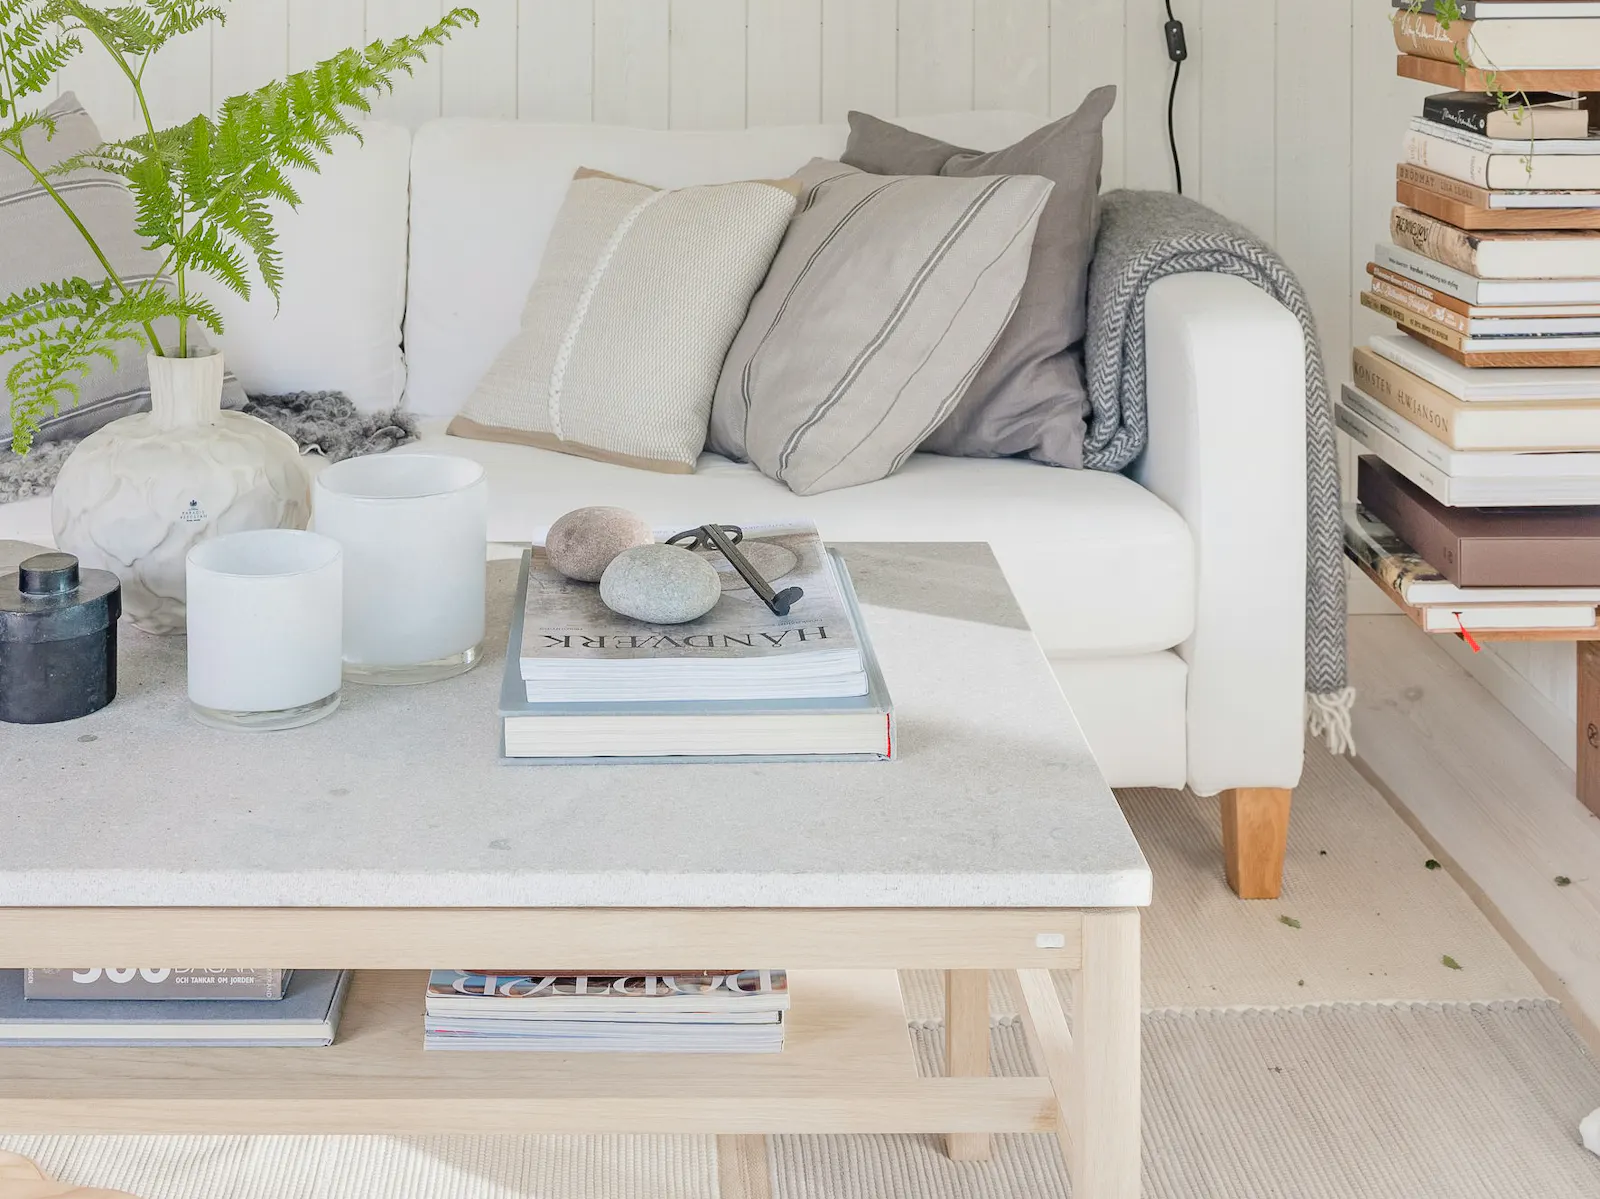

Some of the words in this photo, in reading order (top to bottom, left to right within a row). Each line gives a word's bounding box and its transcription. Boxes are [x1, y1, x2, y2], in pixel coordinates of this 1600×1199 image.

[538, 626, 833, 648] HÅNDVÆRK
[175, 976, 189, 984] OCH
[191, 976, 215, 984] TANKAR
[217, 976, 228, 984] OM
[229, 976, 255, 986] JORDEN
